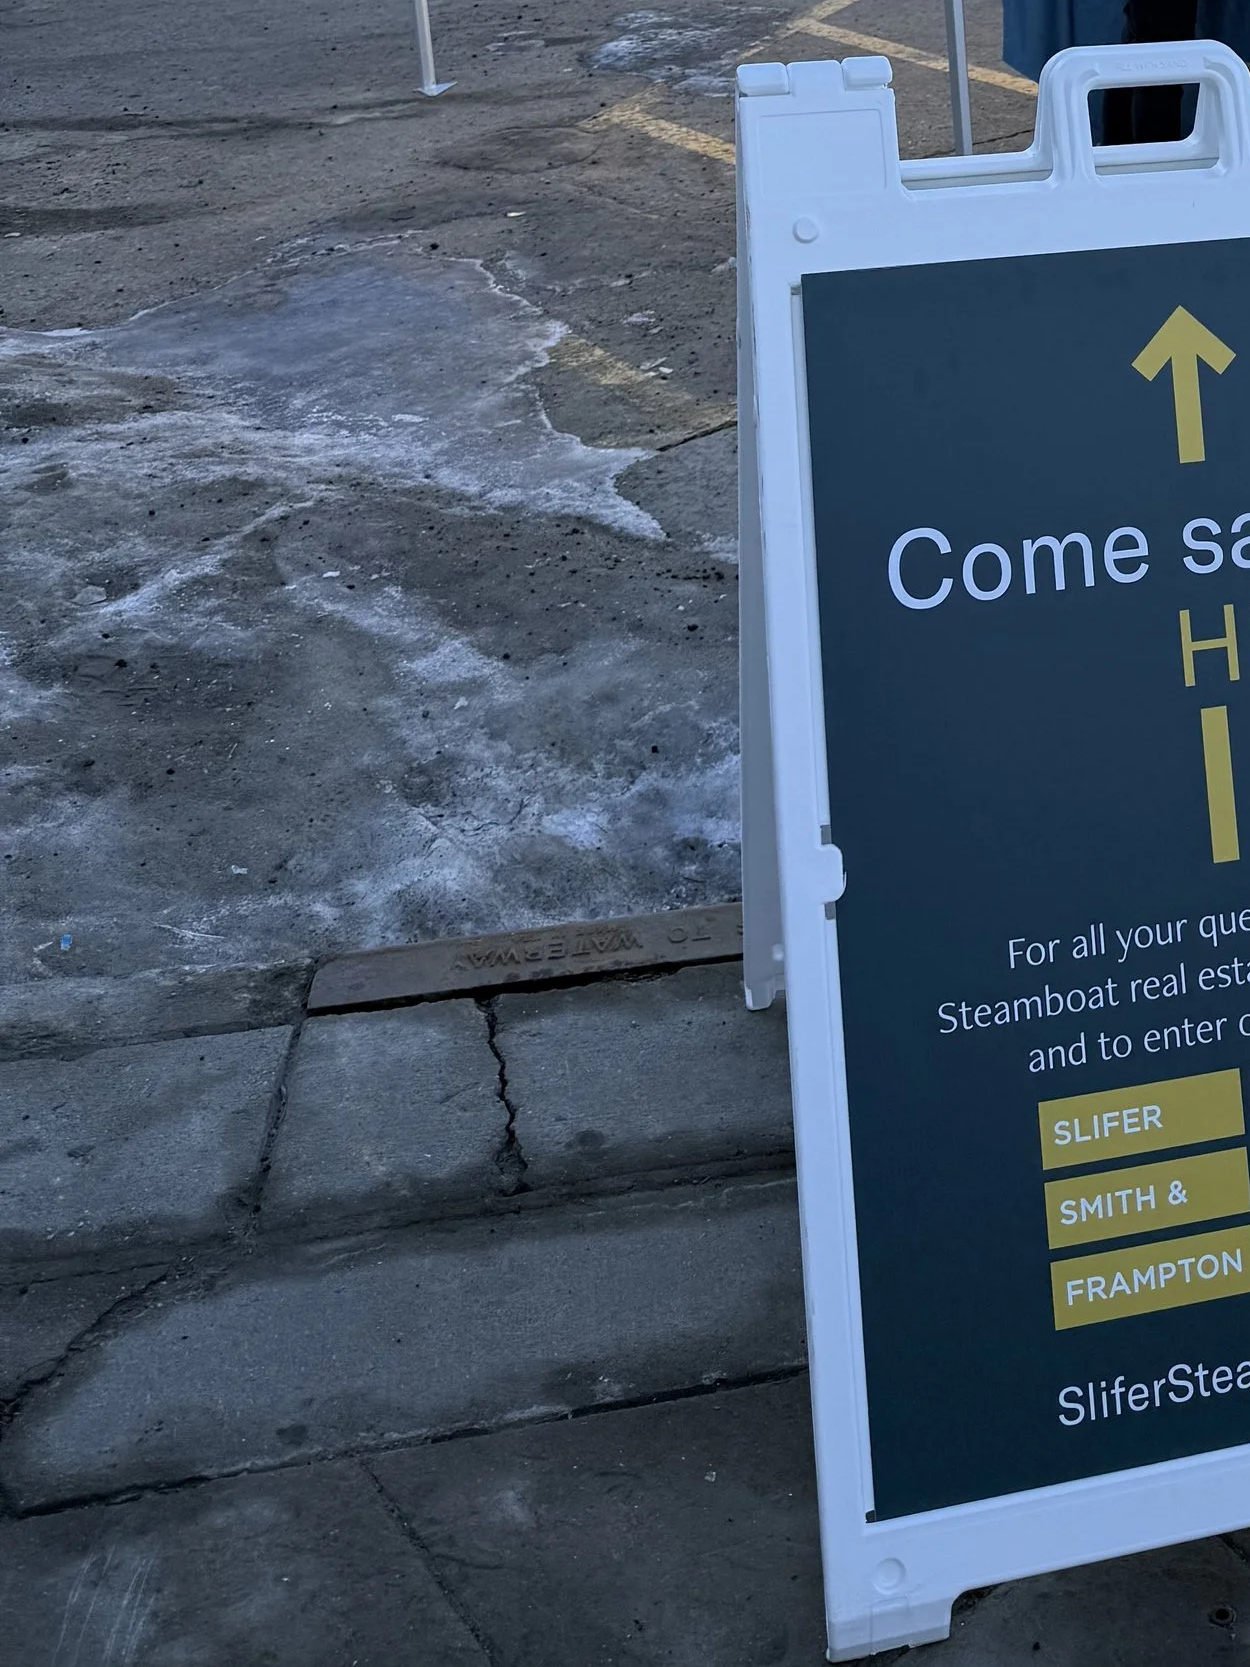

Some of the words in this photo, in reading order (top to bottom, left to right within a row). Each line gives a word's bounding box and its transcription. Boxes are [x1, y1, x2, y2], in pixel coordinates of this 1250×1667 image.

[887, 525, 1150, 610] Come
[1008, 937, 1061, 969] For
[1072, 922, 1105, 959] all
[1115, 918, 1188, 963] your
[938, 977, 1120, 1034] Steamboat
[1130, 962, 1187, 1003] real
[1028, 1032, 1087, 1073] and
[1097, 1031, 1132, 1061] to
[1143, 1019, 1228, 1054] enter
[1054, 1104, 1163, 1146] SLIFER
[1060, 1184, 1156, 1226] SMITH
[1167, 1180, 1188, 1206] &
[1066, 1248, 1243, 1306] FRAMPTON
